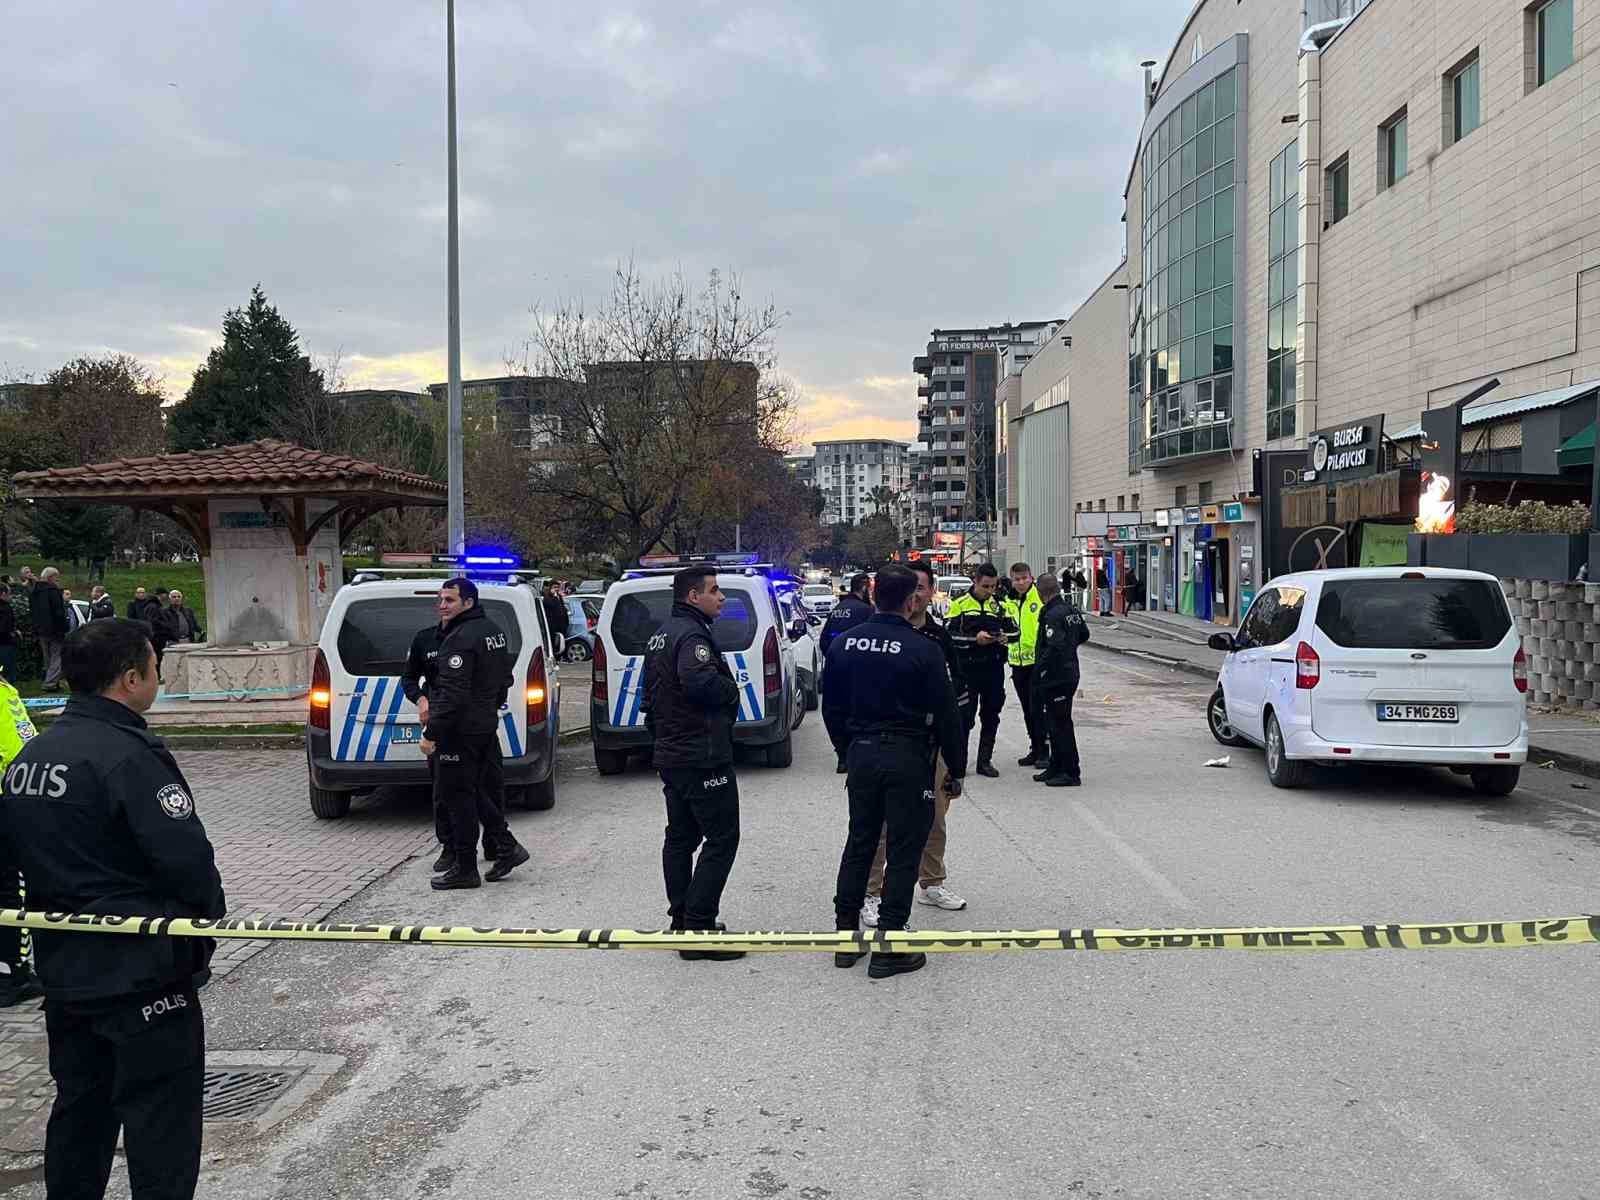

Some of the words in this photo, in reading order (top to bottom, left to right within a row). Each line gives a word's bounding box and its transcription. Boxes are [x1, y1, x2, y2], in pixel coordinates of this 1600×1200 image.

[1333, 426, 1363, 447] BURSA
[844, 637, 902, 654] POLİS
[1386, 706, 1402, 718] 34
[1406, 707, 1430, 719] FMG
[1432, 707, 1456, 719] 269
[401, 727, 413, 739] 16
